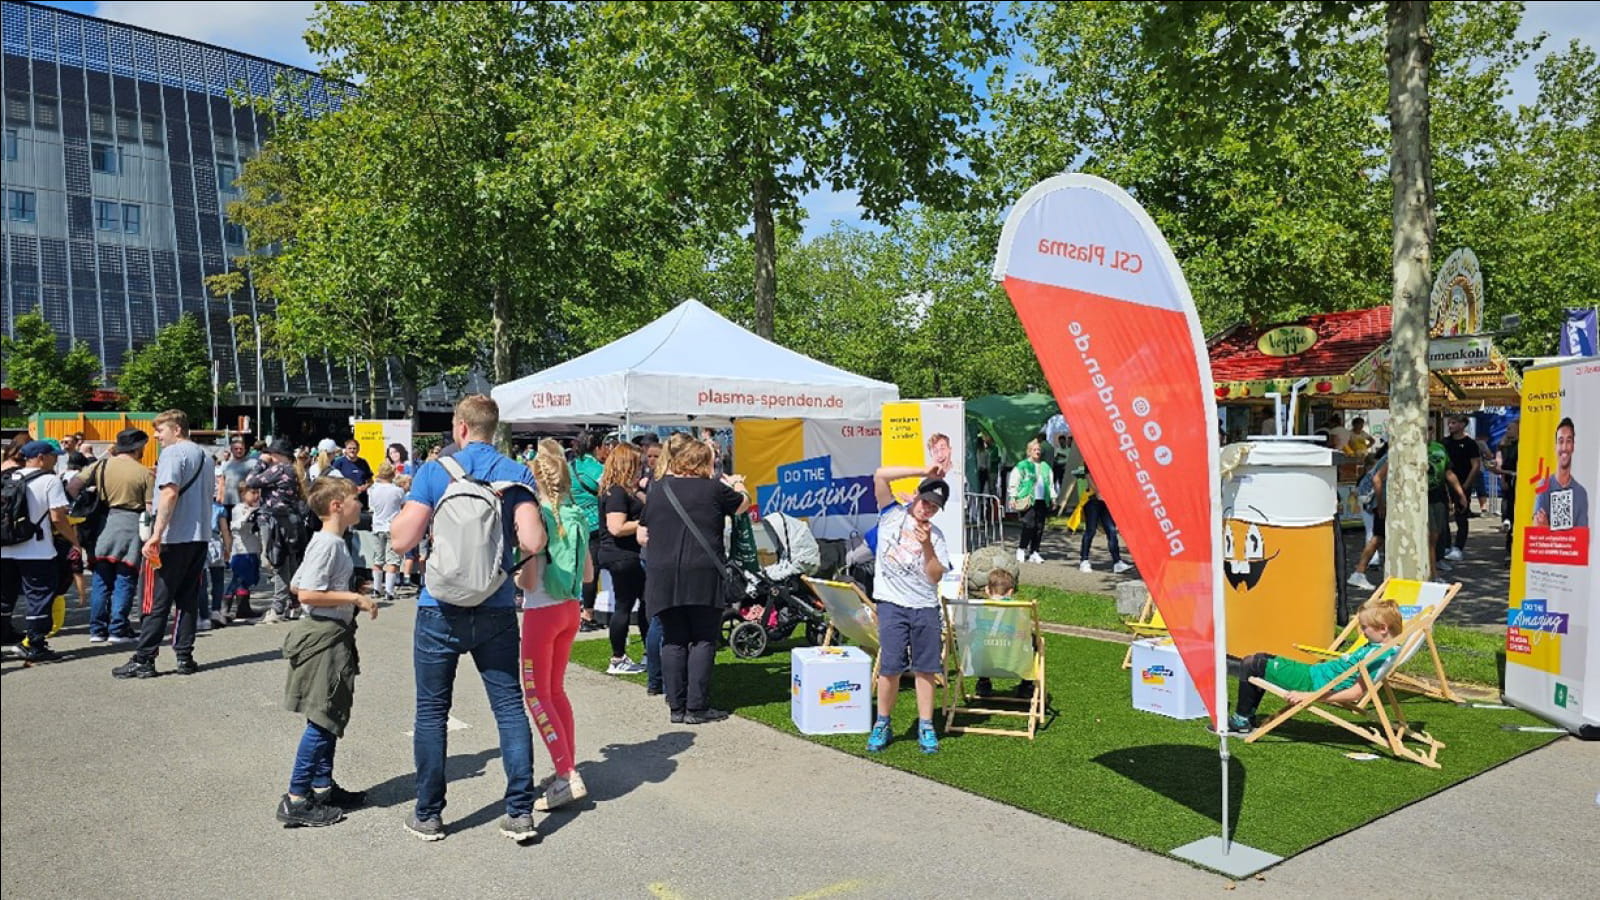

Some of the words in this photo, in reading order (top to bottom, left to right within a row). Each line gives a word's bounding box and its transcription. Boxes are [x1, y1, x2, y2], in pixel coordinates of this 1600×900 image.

[1268, 331, 1307, 354] Veggie
[697, 388, 844, 409] plasma-spenden.de
[856, 425, 882, 438] Plasm
[783, 469, 801, 484] DO
[802, 467, 826, 483] THE
[762, 481, 869, 521] Amazing
[1512, 610, 1564, 640] Amazing
